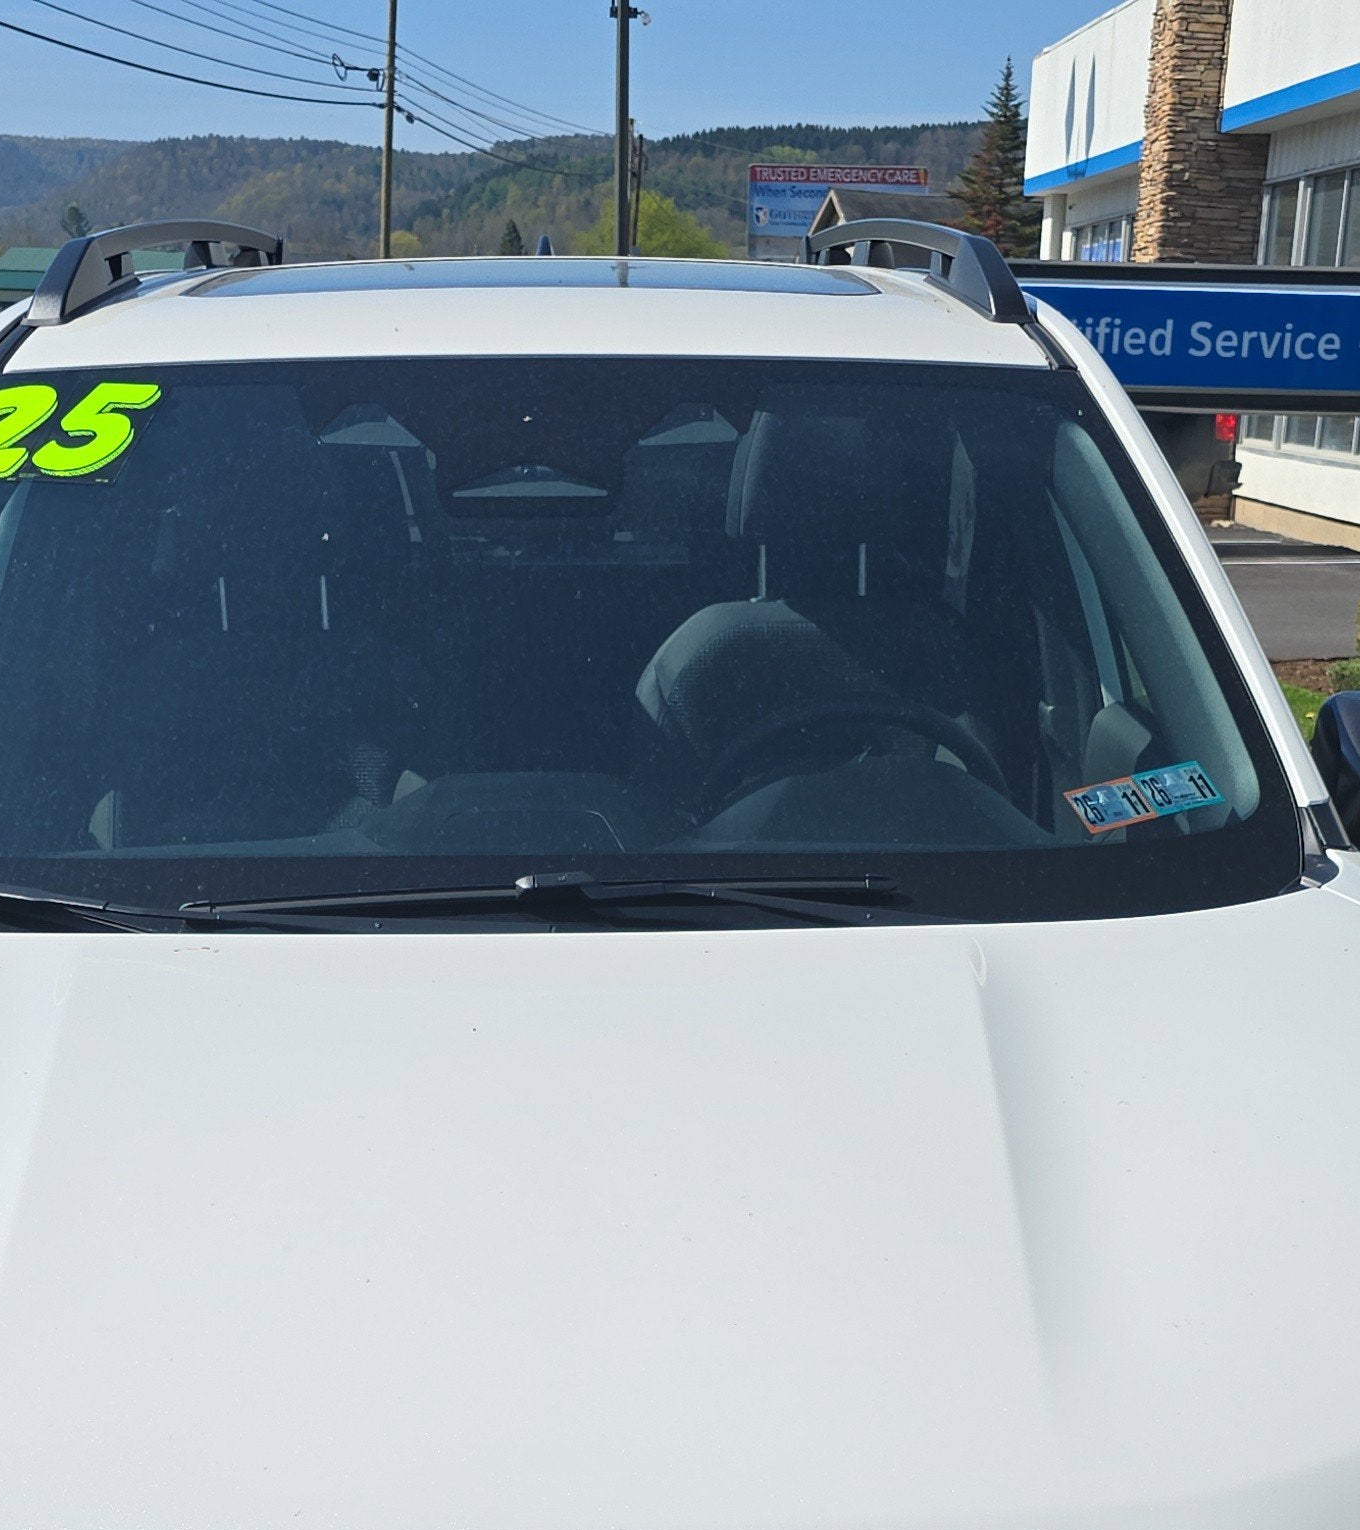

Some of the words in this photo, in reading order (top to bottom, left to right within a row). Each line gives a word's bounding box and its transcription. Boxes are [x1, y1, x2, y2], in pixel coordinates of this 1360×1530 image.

[755, 167, 808, 182] TRUSTED
[809, 168, 884, 183] EMERGENCY
[885, 169, 918, 183] CARE
[1073, 316, 1174, 356] ified
[1188, 320, 1341, 360] Service
[1121, 789, 1151, 816] 11
[1141, 777, 1172, 808] 26
[1187, 773, 1217, 799] 11
